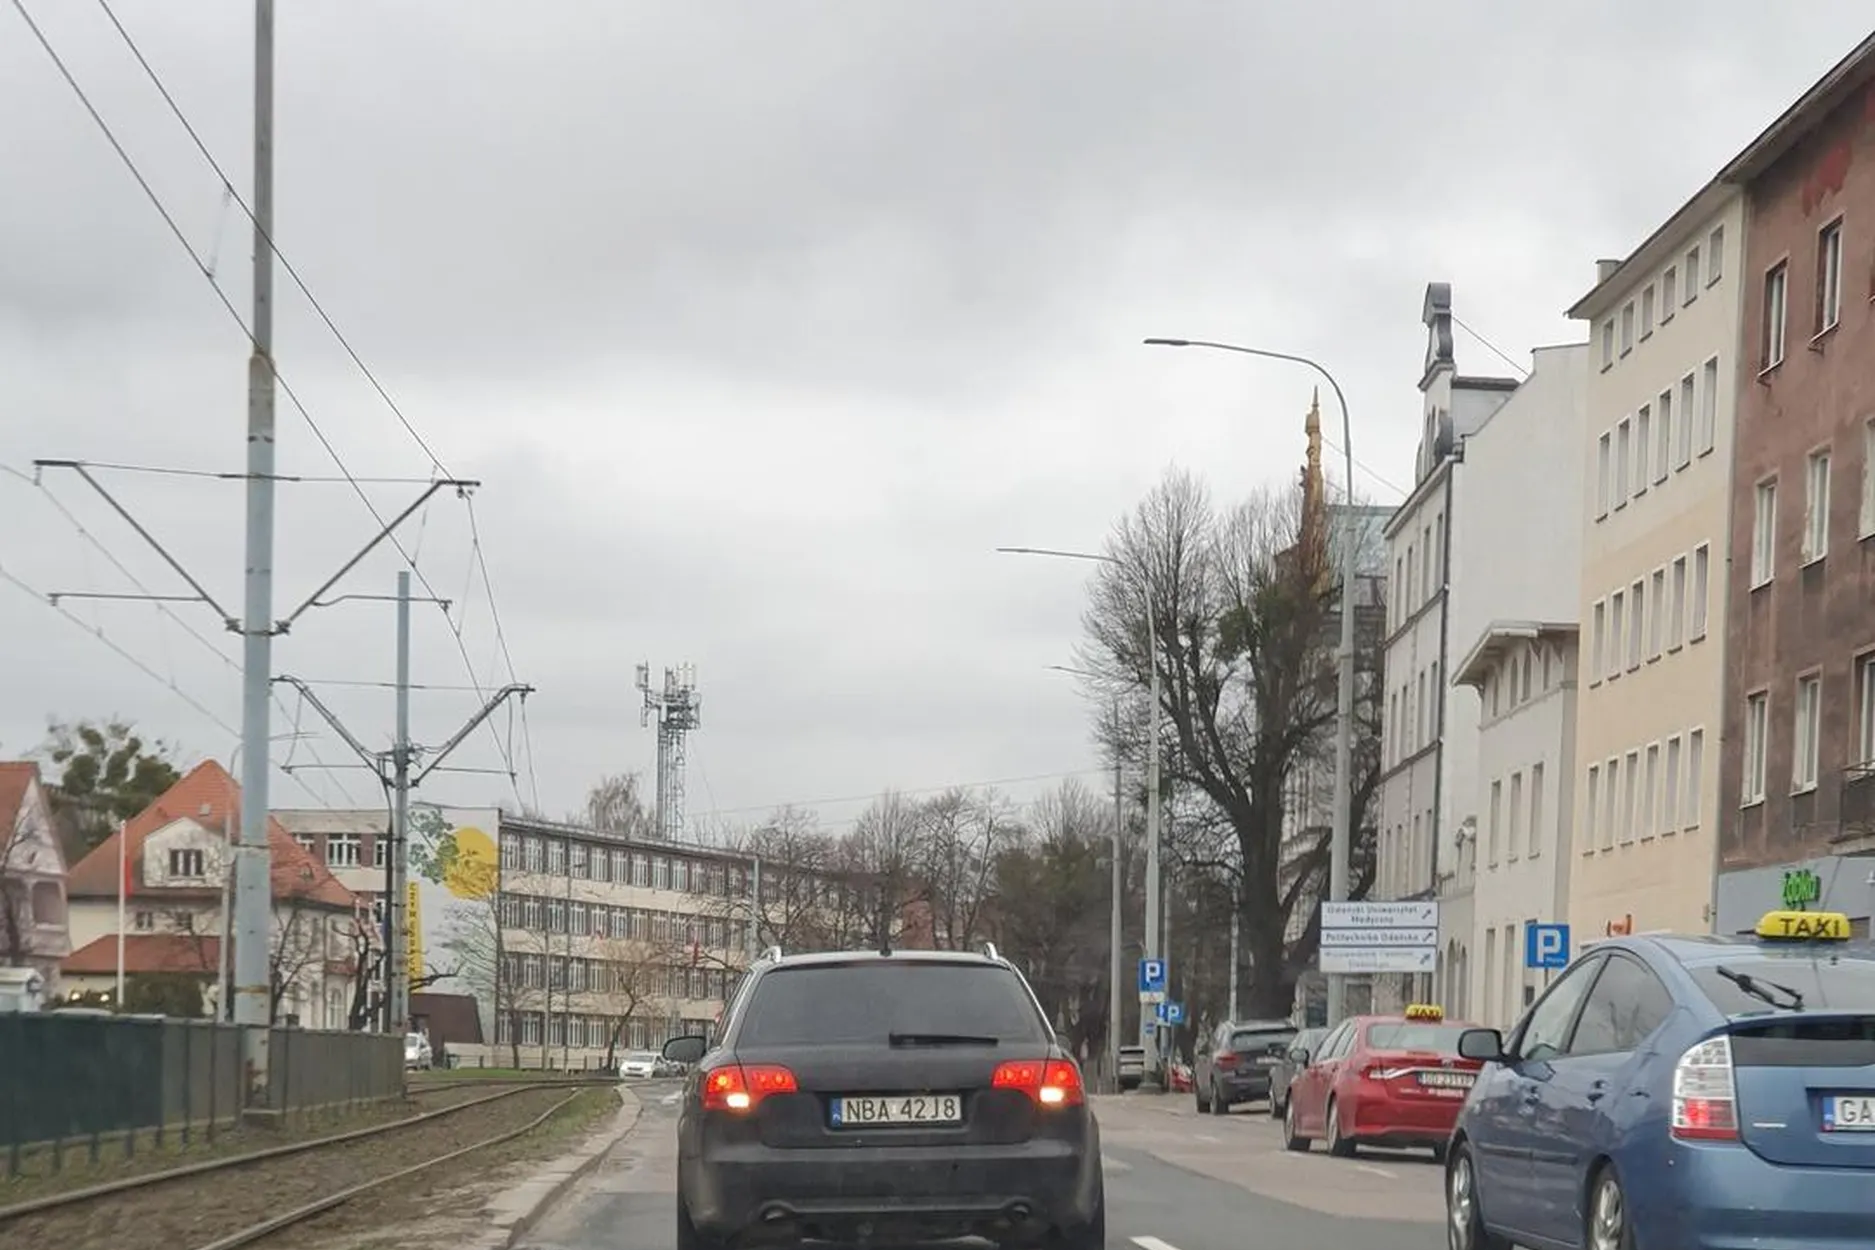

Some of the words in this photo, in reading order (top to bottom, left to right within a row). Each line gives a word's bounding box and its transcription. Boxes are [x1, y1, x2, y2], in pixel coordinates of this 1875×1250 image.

[1779, 917, 1841, 938] TAXI
[1537, 929, 1562, 963] P
[1145, 962, 1161, 983] P
[1167, 1004, 1180, 1022] P
[847, 1100, 890, 1121] NBA
[1839, 1099, 1873, 1123] GA
